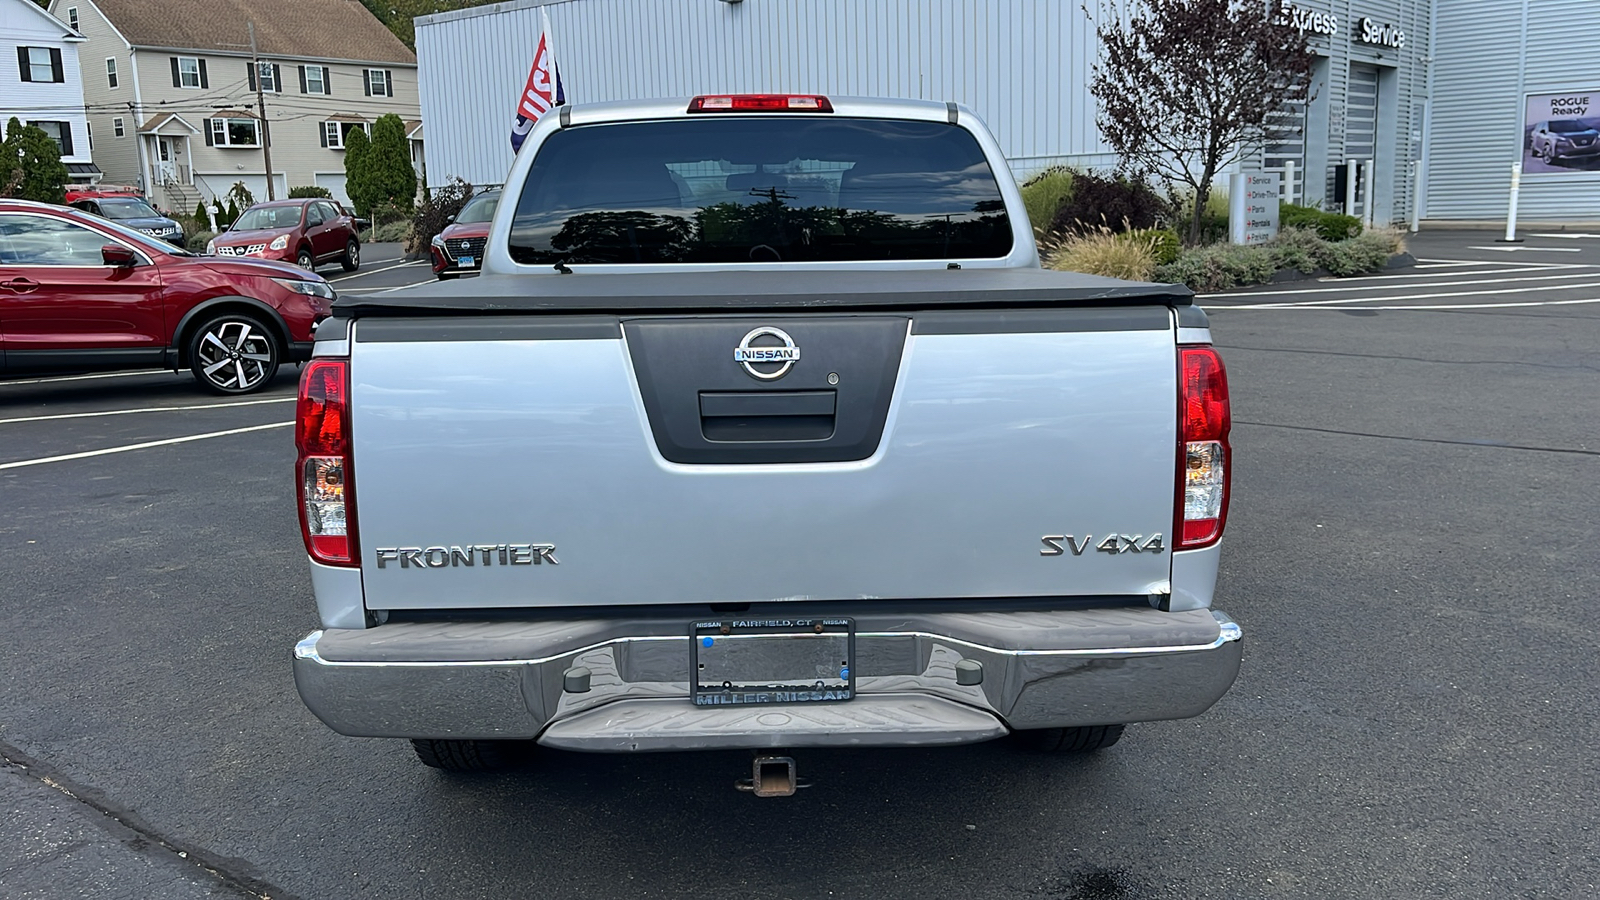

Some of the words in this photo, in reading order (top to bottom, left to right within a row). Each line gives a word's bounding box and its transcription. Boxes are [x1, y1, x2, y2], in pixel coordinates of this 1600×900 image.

[1280, 0, 1338, 36] Express
[1362, 17, 1405, 48] Service
[1551, 96, 1590, 107] ROGUE
[1552, 106, 1588, 116] Ready
[1252, 177, 1271, 185] Service
[1252, 190, 1277, 199] Drive-Thru
[1252, 233, 1269, 241] Parking
[741, 349, 794, 359] NISSAN
[1040, 534, 1093, 556] SV
[375, 543, 560, 569] FRONTIER
[732, 619, 794, 628] FAIRFIELD,
[697, 693, 770, 705] MILLER
[776, 690, 850, 702] NISSAN
